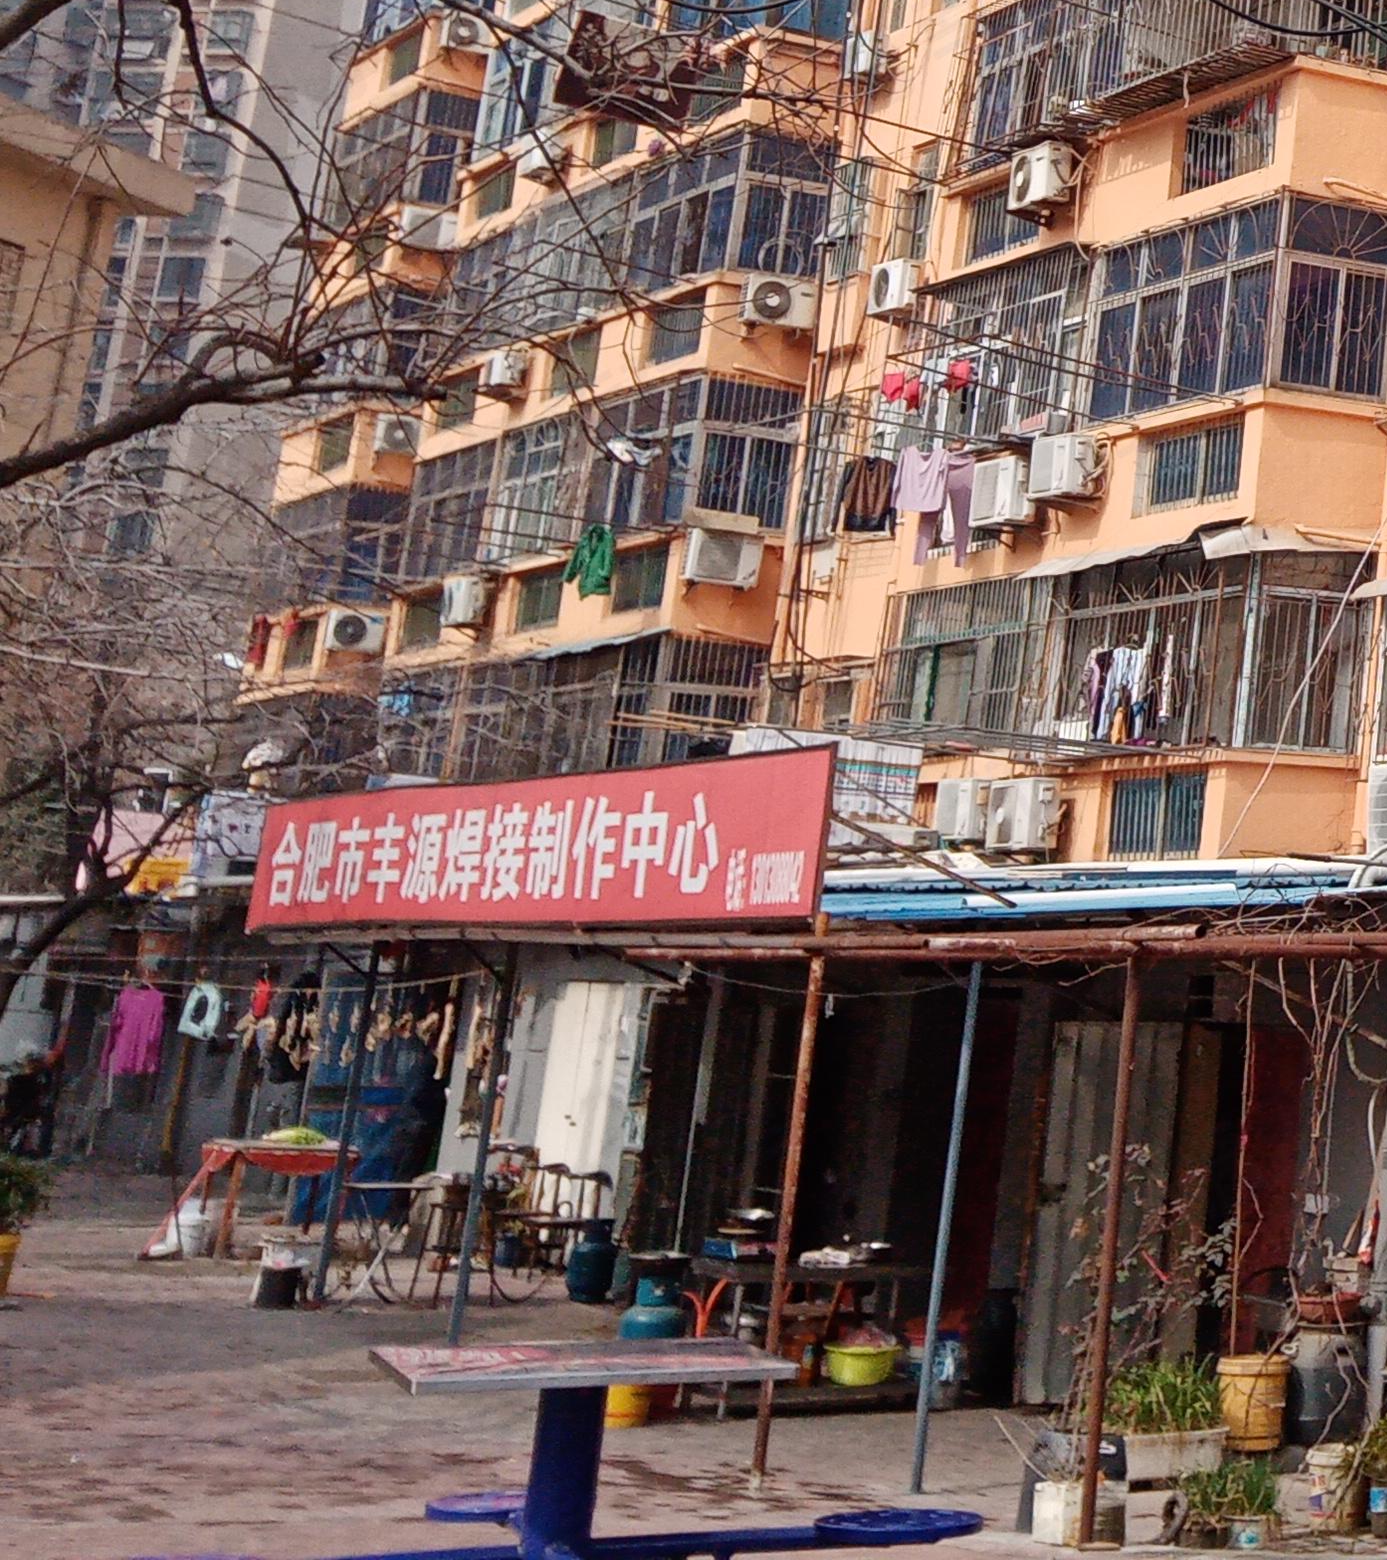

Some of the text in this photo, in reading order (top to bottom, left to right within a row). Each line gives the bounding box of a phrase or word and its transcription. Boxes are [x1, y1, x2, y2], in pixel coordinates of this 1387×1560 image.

[269, 791, 719, 908] 合肥市丰源焊接制作中心
